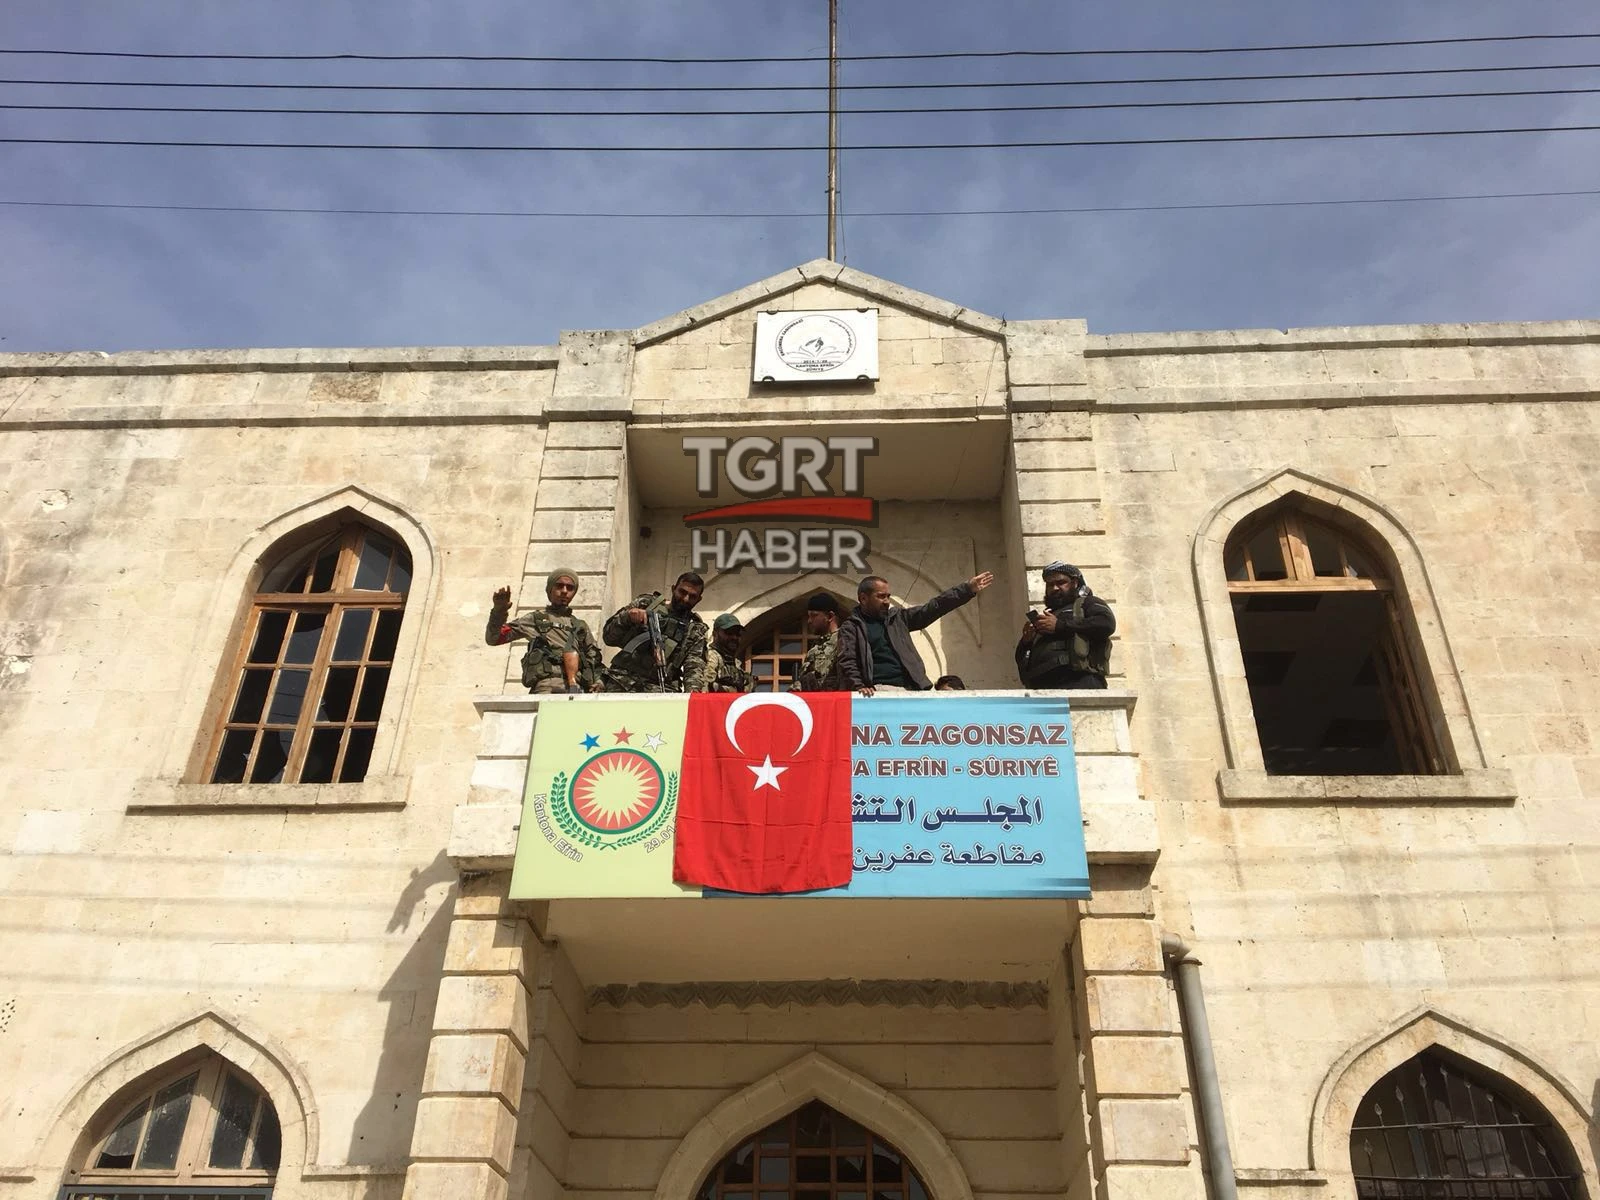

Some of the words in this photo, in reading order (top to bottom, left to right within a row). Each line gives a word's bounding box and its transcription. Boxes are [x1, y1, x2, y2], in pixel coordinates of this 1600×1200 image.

[900, 723, 1068, 746] ZAGONSAZ
[851, 759, 870, 777] A
[877, 755, 947, 777] EFRÎN
[967, 754, 1060, 777] SÛRIYÊ
[533, 793, 557, 844] Kantona
[921, 794, 1044, 832] المجلس
[852, 843, 936, 872] عفرين
[940, 843, 1045, 866] مقاطعة
